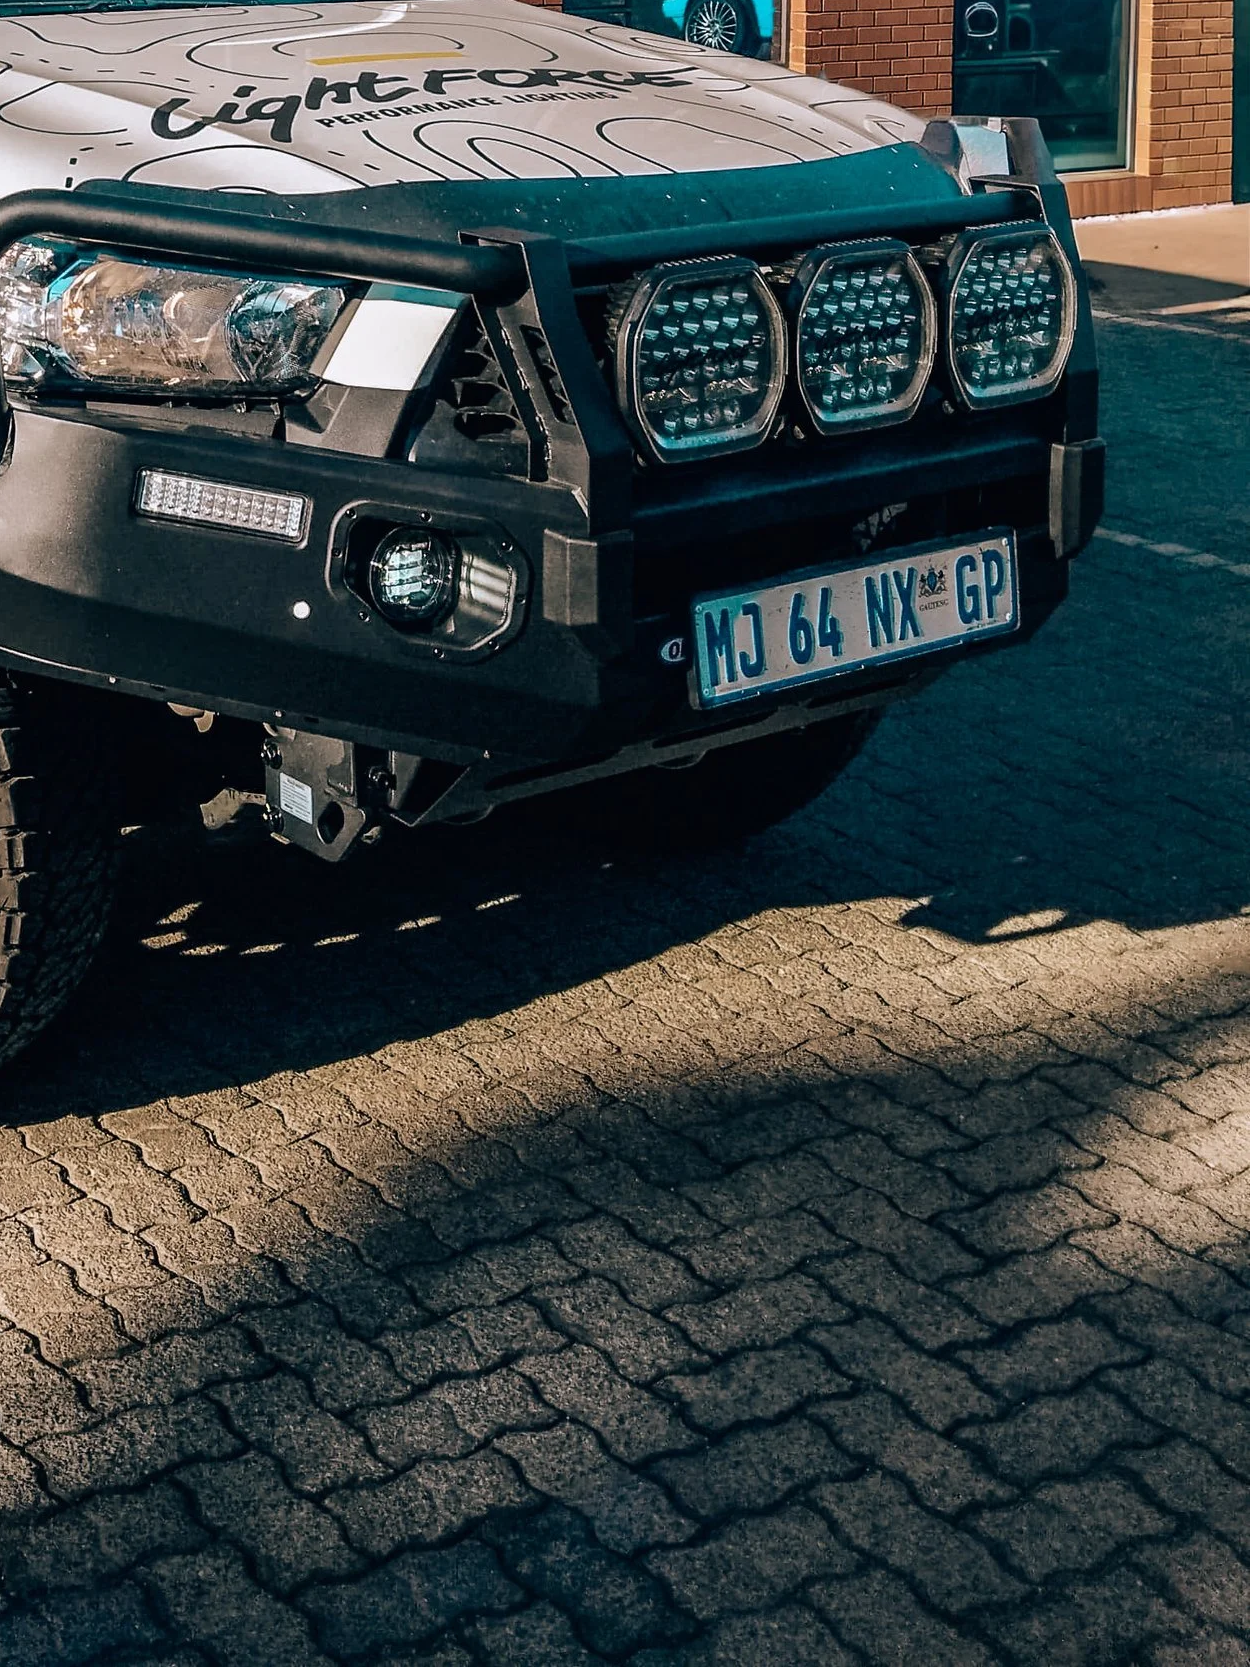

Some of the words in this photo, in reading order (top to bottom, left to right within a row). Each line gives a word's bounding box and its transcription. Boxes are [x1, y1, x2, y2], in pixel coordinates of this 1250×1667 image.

[315, 94, 500, 129] PERFORMANCE
[503, 88, 621, 108] LIGHTING
[703, 601, 766, 687] MJ
[788, 586, 844, 666] 64
[864, 566, 922, 648] NX
[955, 548, 1005, 625] GP
